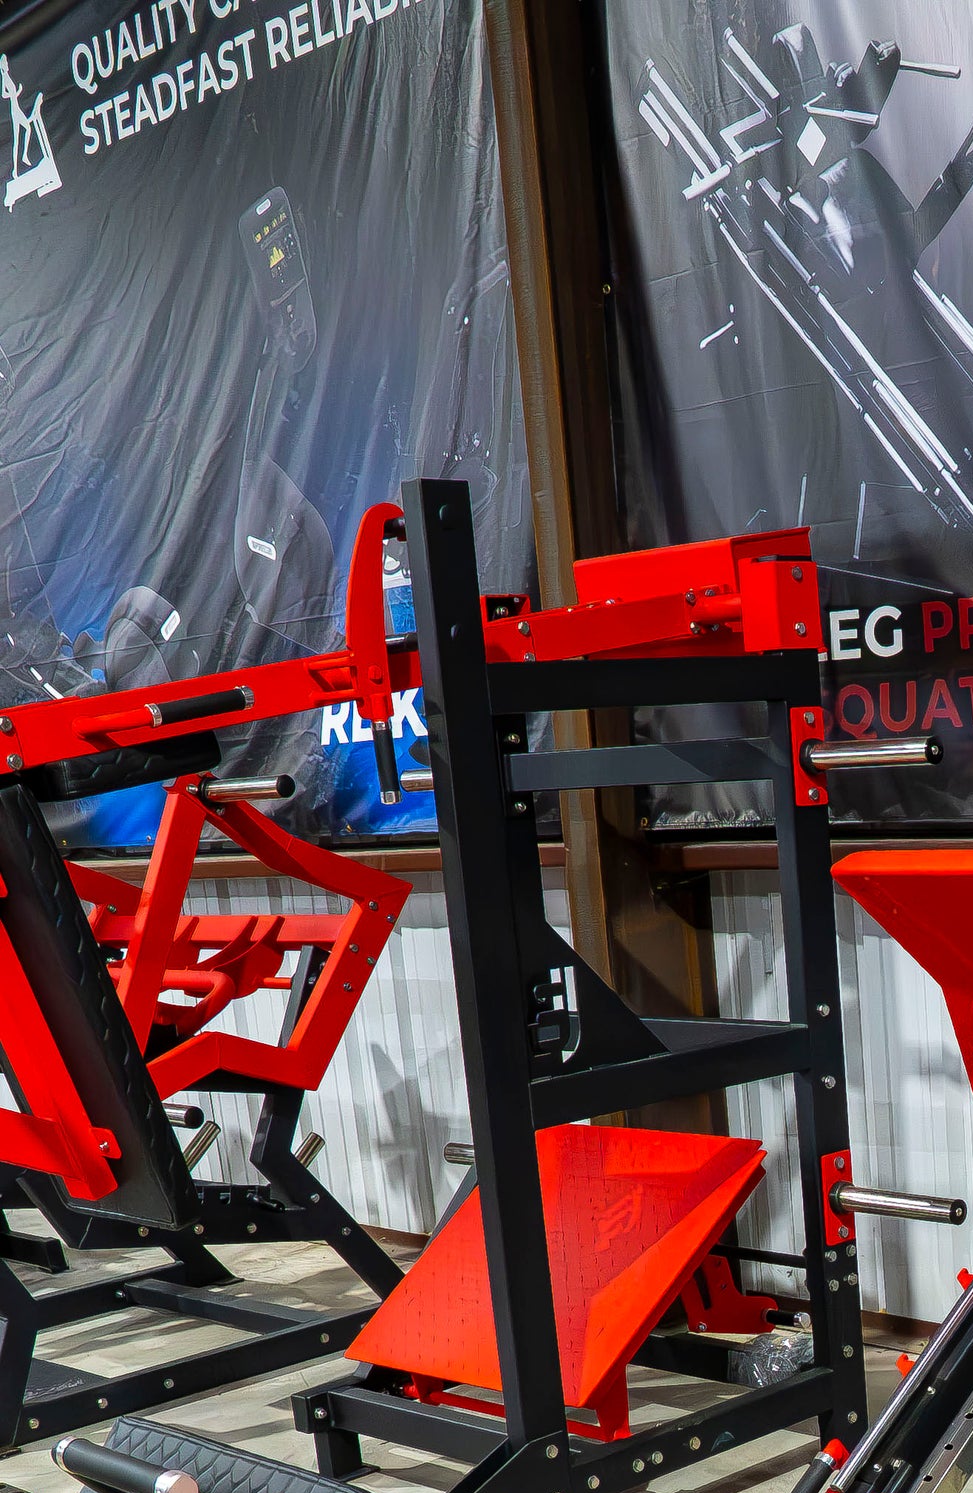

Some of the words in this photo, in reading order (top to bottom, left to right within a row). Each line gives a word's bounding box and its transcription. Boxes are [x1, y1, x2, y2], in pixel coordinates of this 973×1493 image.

[71, 0, 196, 95] QUALITY
[80, 29, 256, 155] STEADFAST
[818, 605, 903, 661] EG
